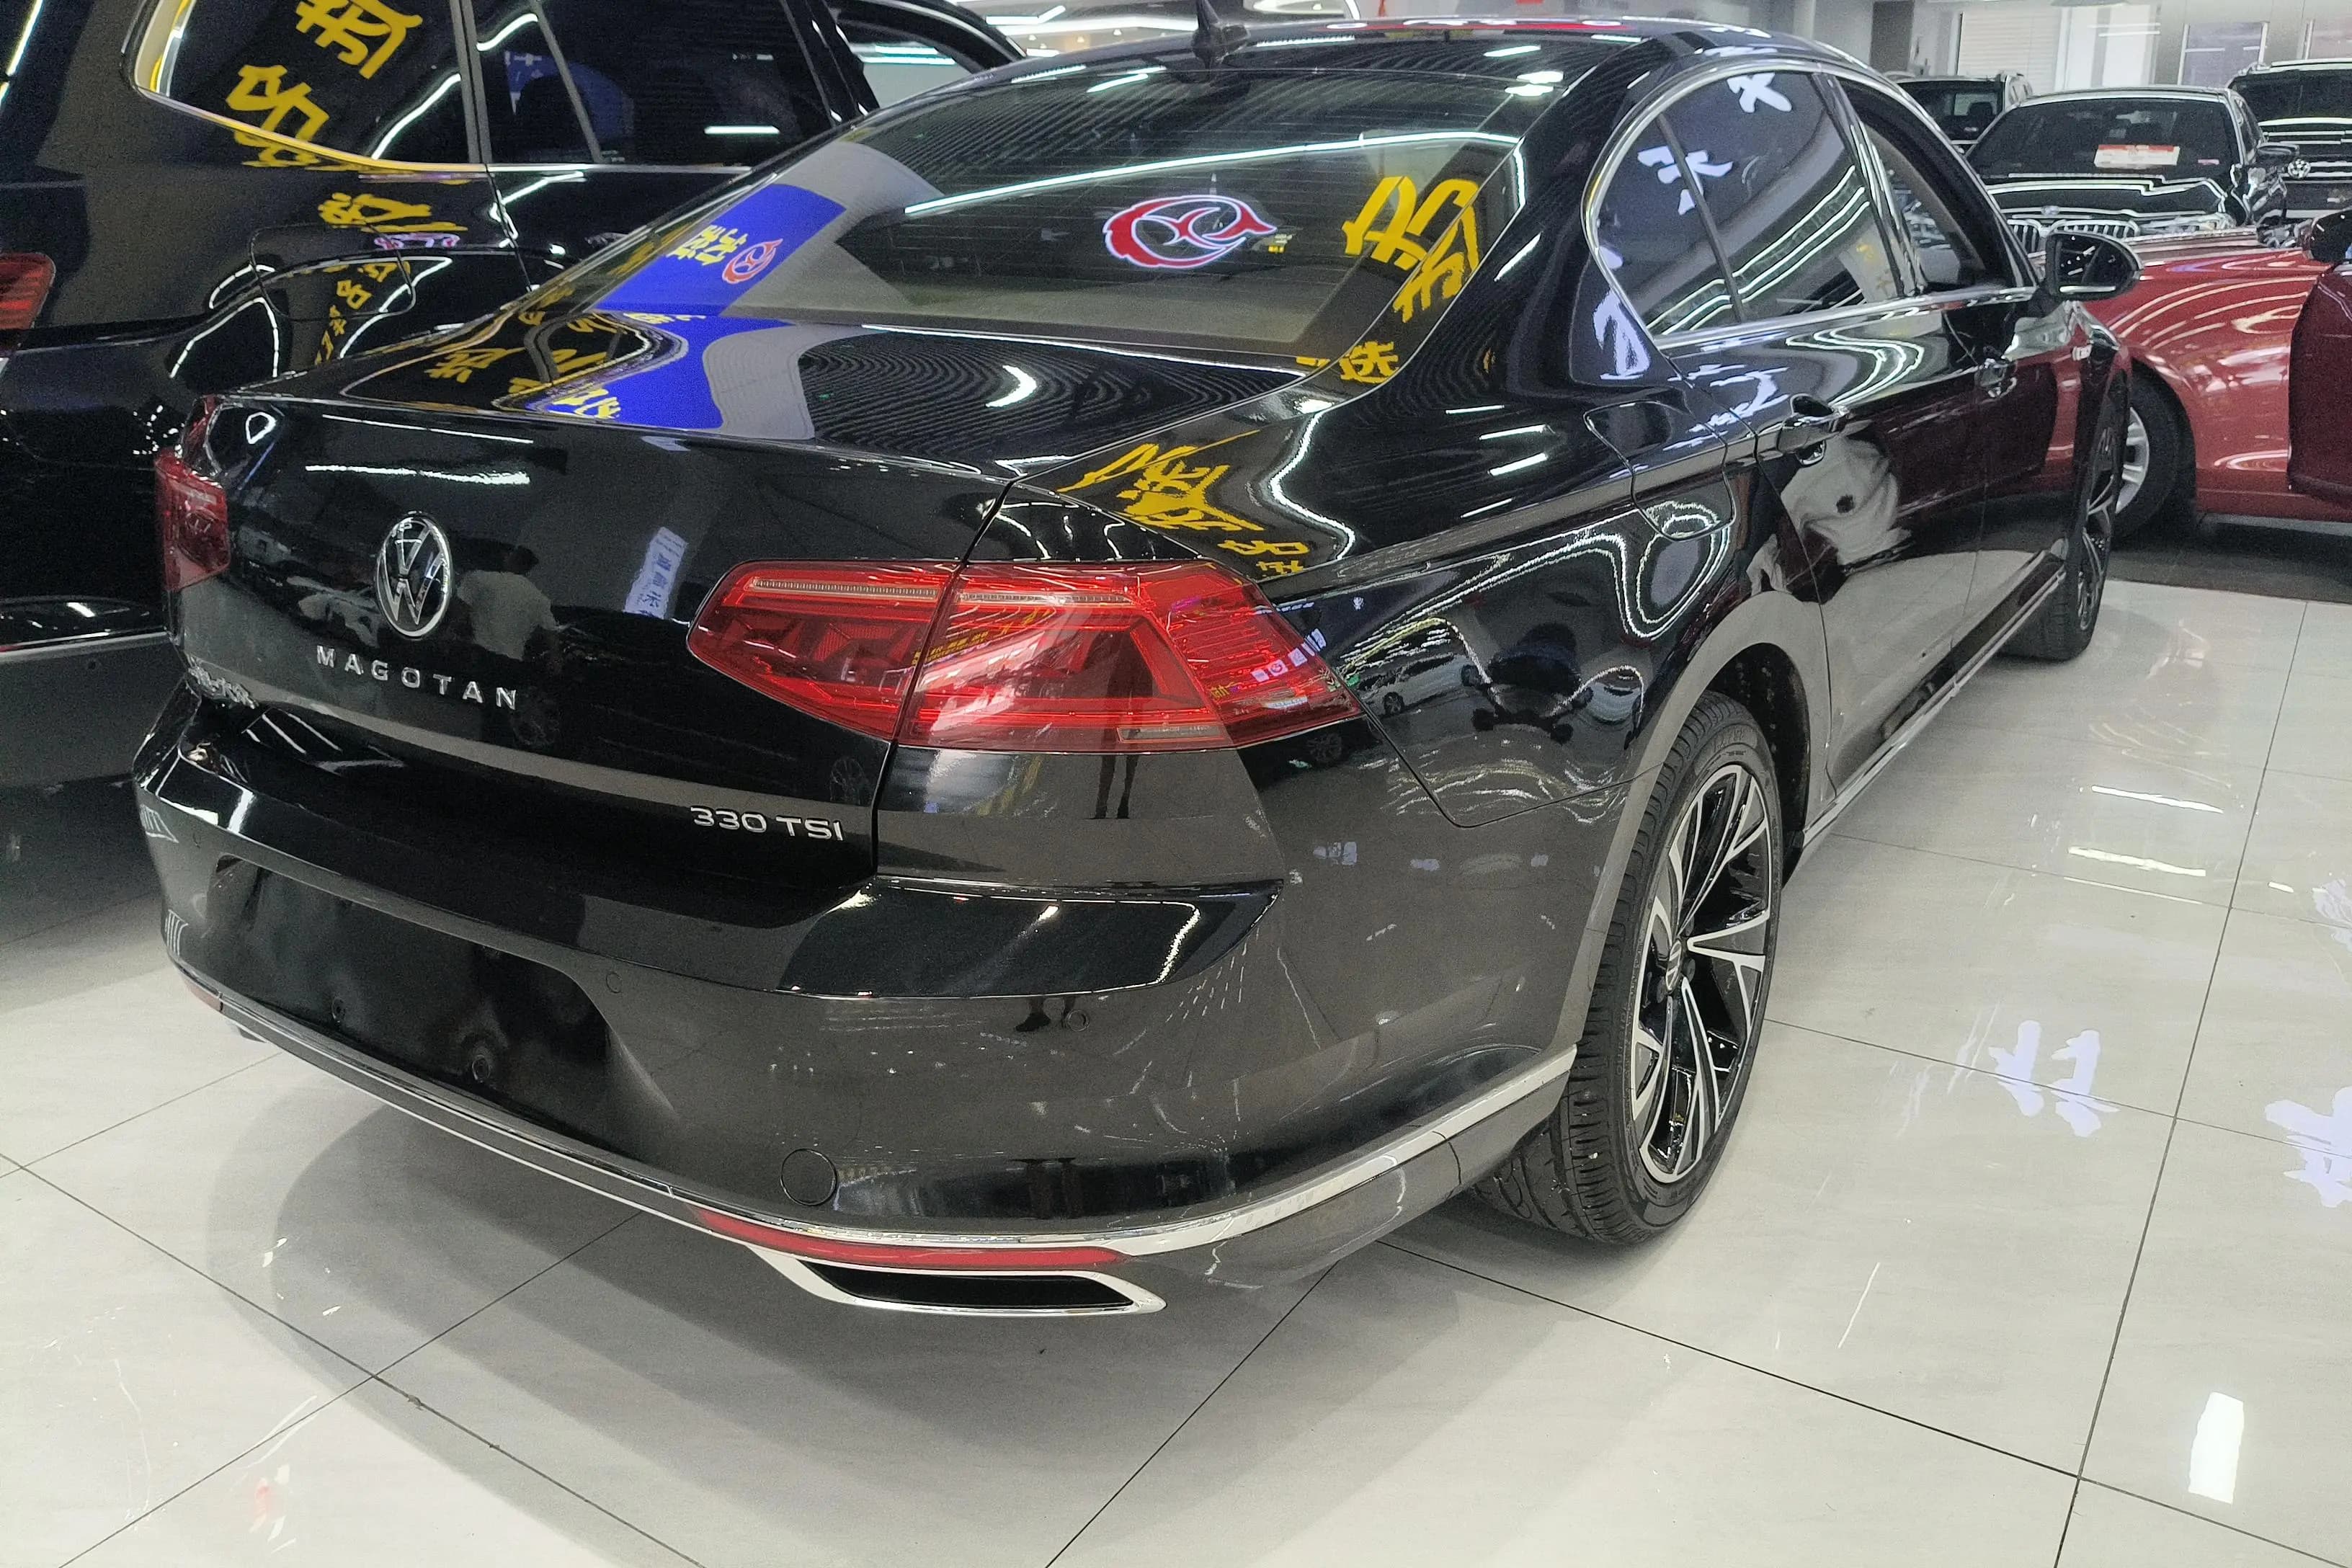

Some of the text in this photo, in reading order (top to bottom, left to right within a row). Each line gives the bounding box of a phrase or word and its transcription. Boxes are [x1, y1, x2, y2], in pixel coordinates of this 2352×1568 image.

[316, 645, 517, 710] MAGOTAN
[690, 806, 844, 841] 330 TSI
